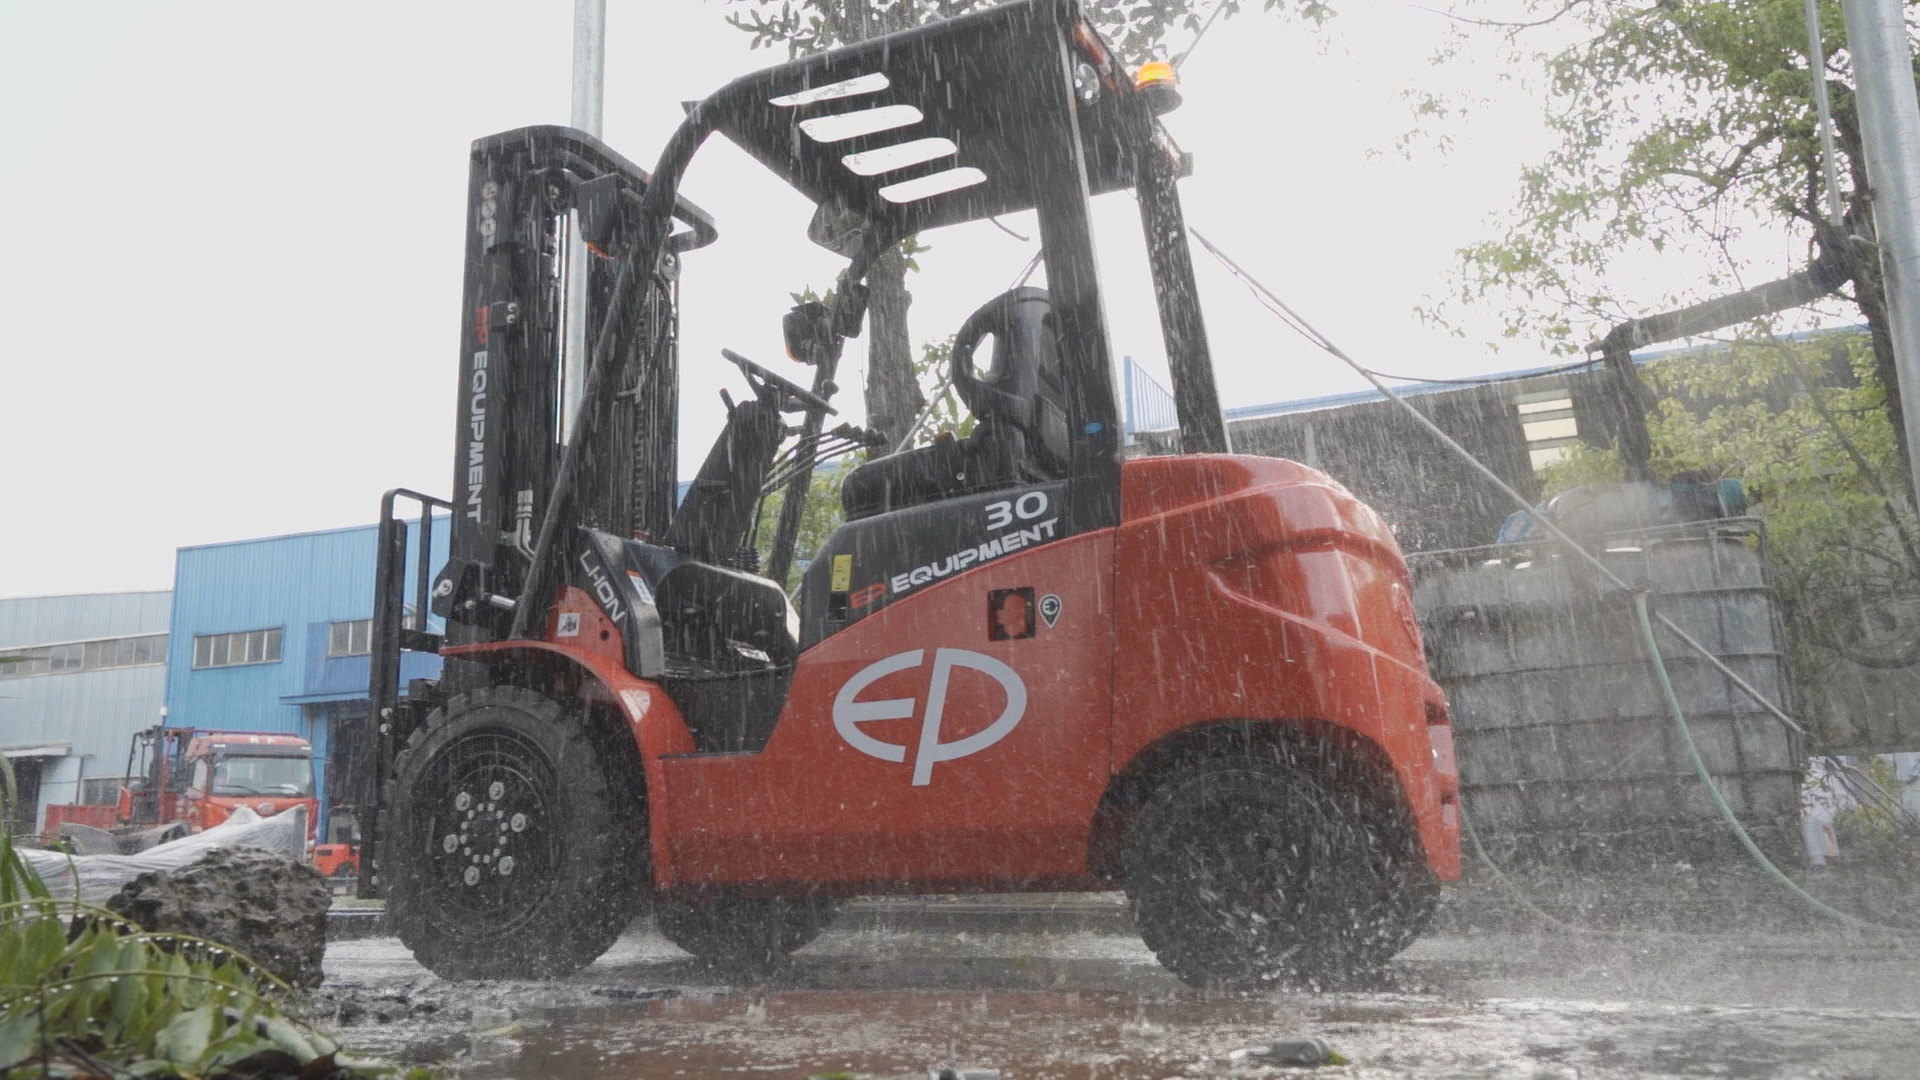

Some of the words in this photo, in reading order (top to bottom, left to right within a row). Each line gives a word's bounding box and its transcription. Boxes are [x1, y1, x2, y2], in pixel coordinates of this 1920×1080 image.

[466, 350, 489, 525] EQUIPMENT
[891, 517, 1059, 594] EQUIPMENT
[984, 490, 1048, 532] 30
[832, 647, 1028, 787] EP
